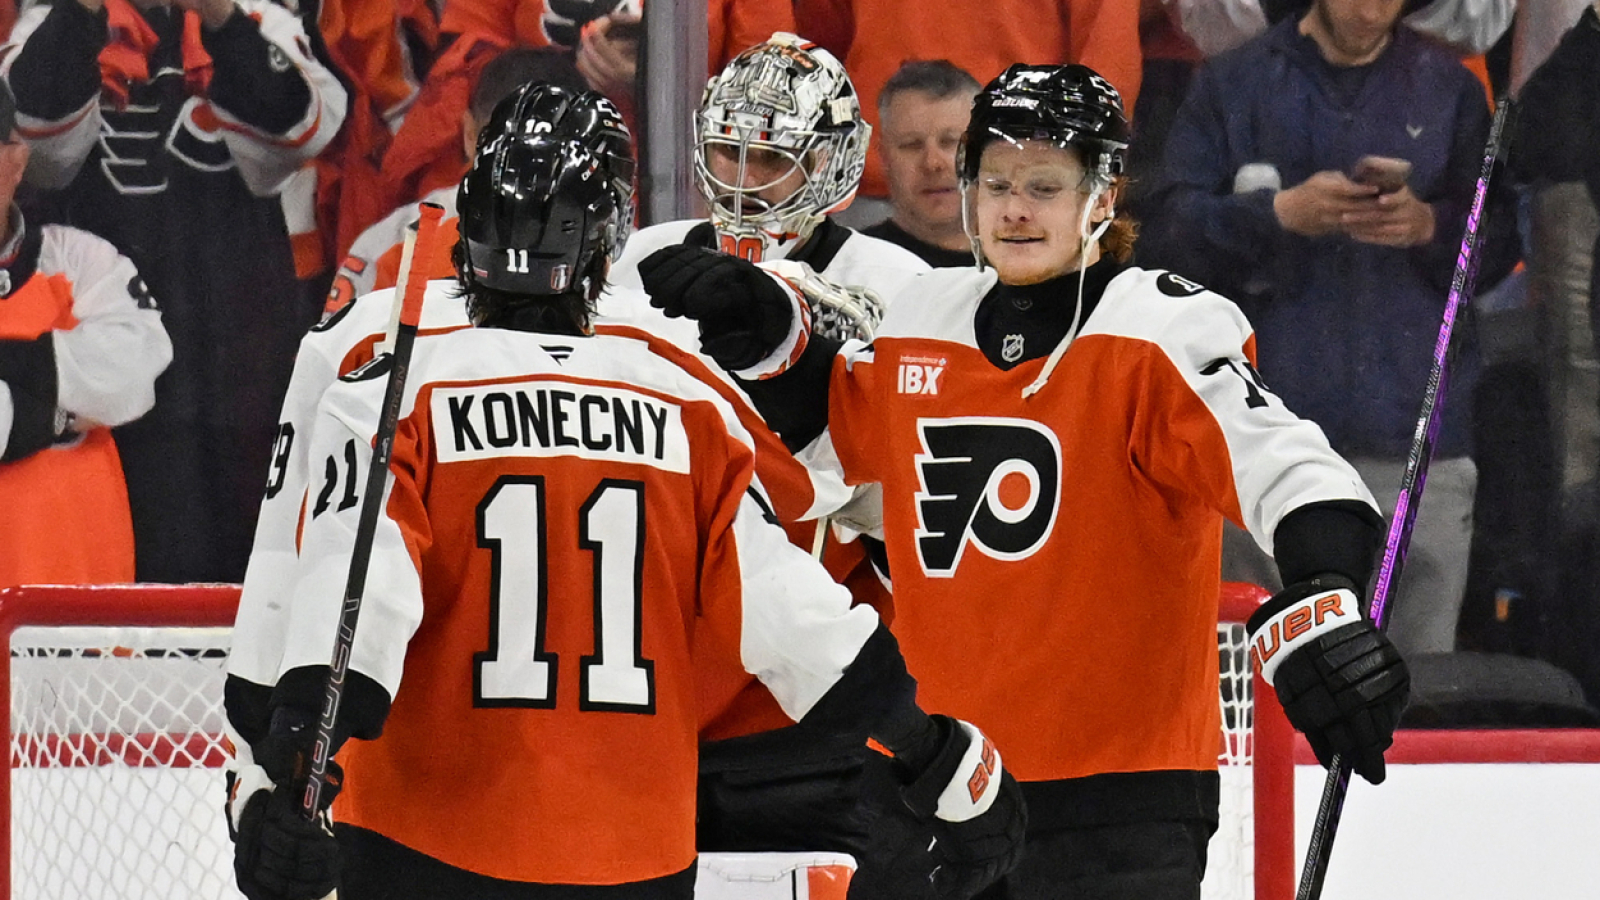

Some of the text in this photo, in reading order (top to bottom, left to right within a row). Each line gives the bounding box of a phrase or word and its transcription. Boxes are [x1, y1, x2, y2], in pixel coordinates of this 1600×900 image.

[506, 248, 529, 274] 11
[897, 365, 944, 395] IBX
[448, 389, 668, 460] KONECNY
[473, 475, 656, 715] 11
